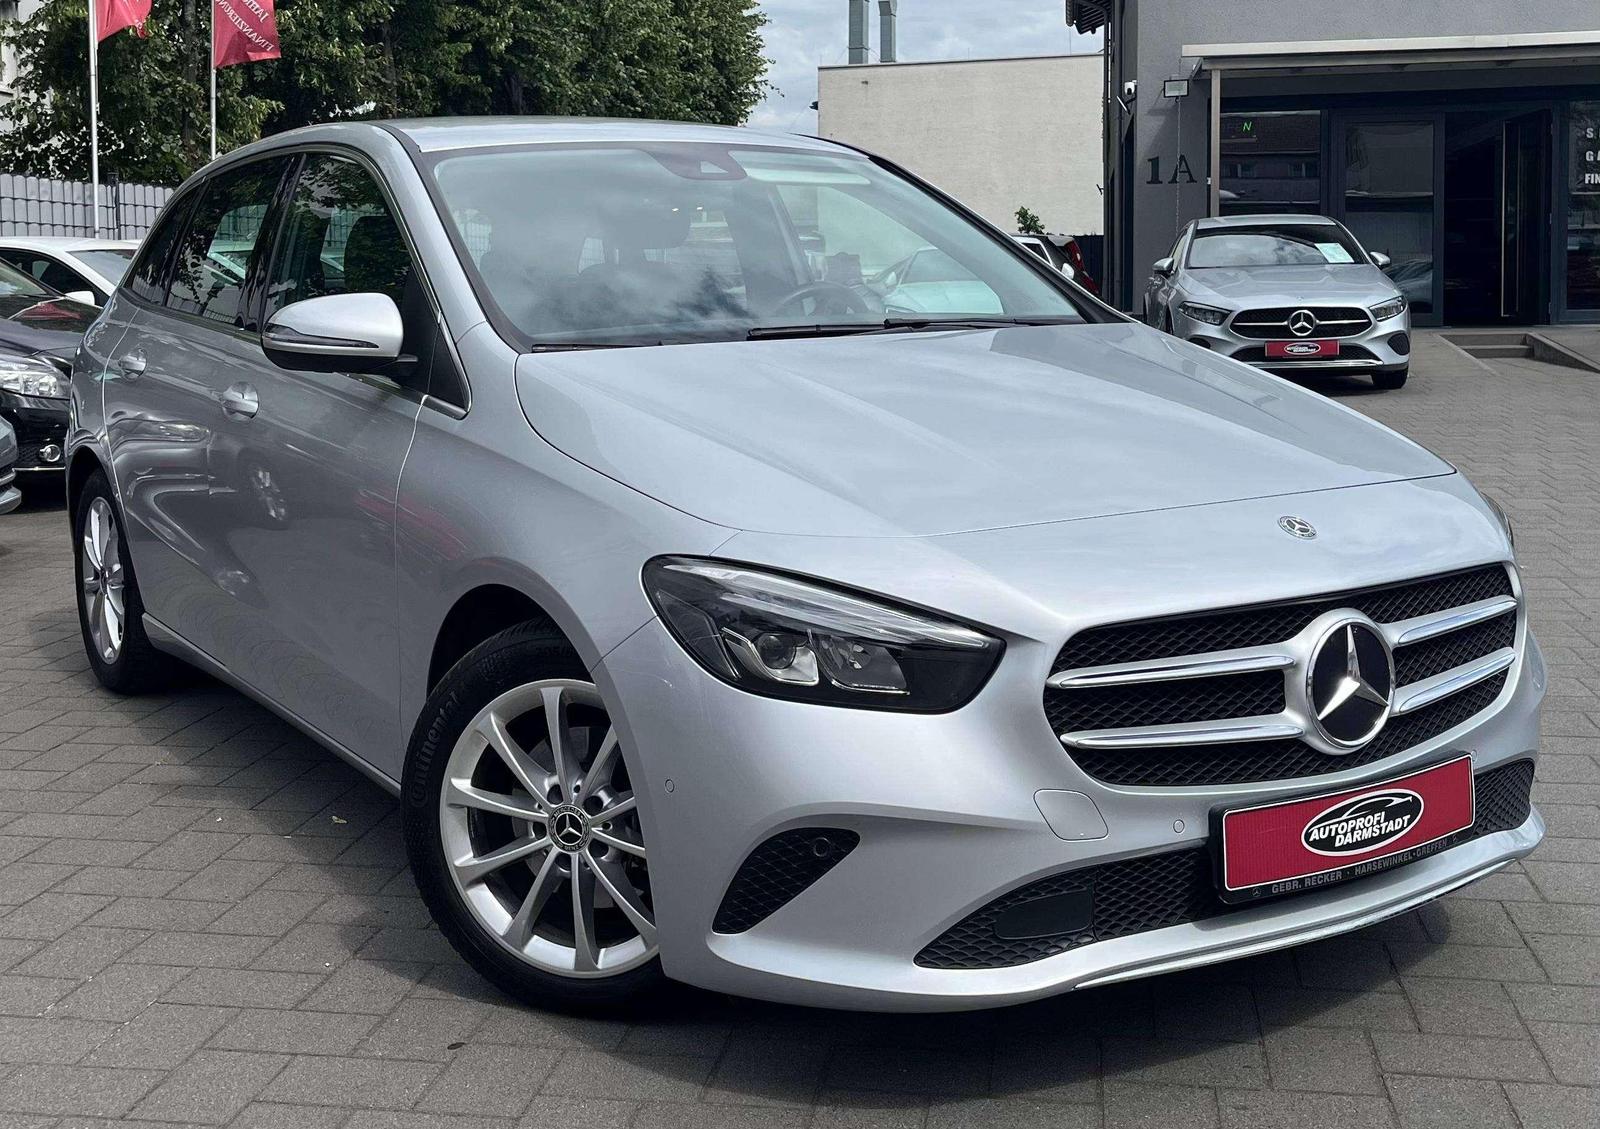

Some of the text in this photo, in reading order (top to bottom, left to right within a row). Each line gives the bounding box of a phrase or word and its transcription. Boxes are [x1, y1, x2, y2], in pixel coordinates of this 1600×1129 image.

[1308, 811, 1386, 842] AUTOPROFI
[1334, 814, 1411, 848] DARMSTADT
[1271, 880, 1302, 894] GEBR.
[1304, 870, 1343, 888] RECKER
